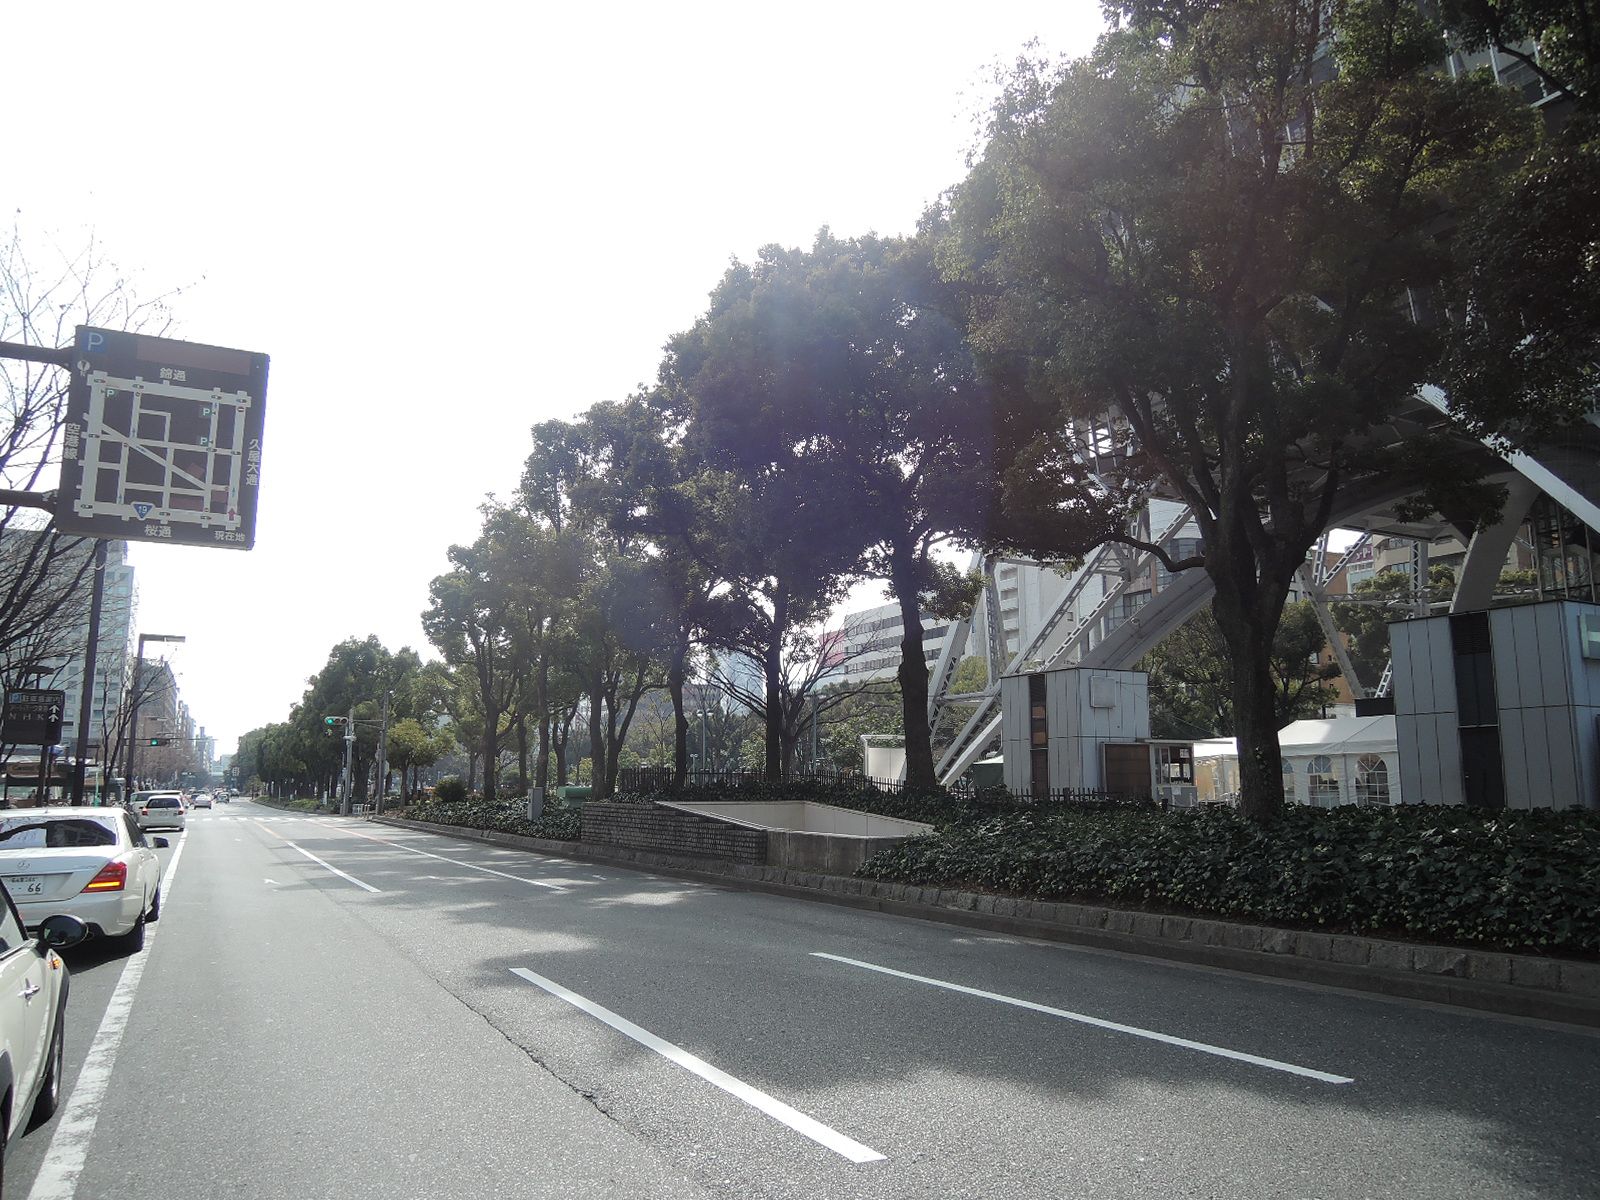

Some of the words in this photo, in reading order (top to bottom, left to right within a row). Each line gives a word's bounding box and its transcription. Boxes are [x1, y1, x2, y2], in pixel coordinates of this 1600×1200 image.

[88, 332, 104, 351] P
[159, 367, 187, 382] 錦通
[246, 438, 261, 486] 久屋大通
[138, 505, 147, 514] 19
[144, 524, 172, 538] 桜通
[214, 530, 246, 542] 現在地
